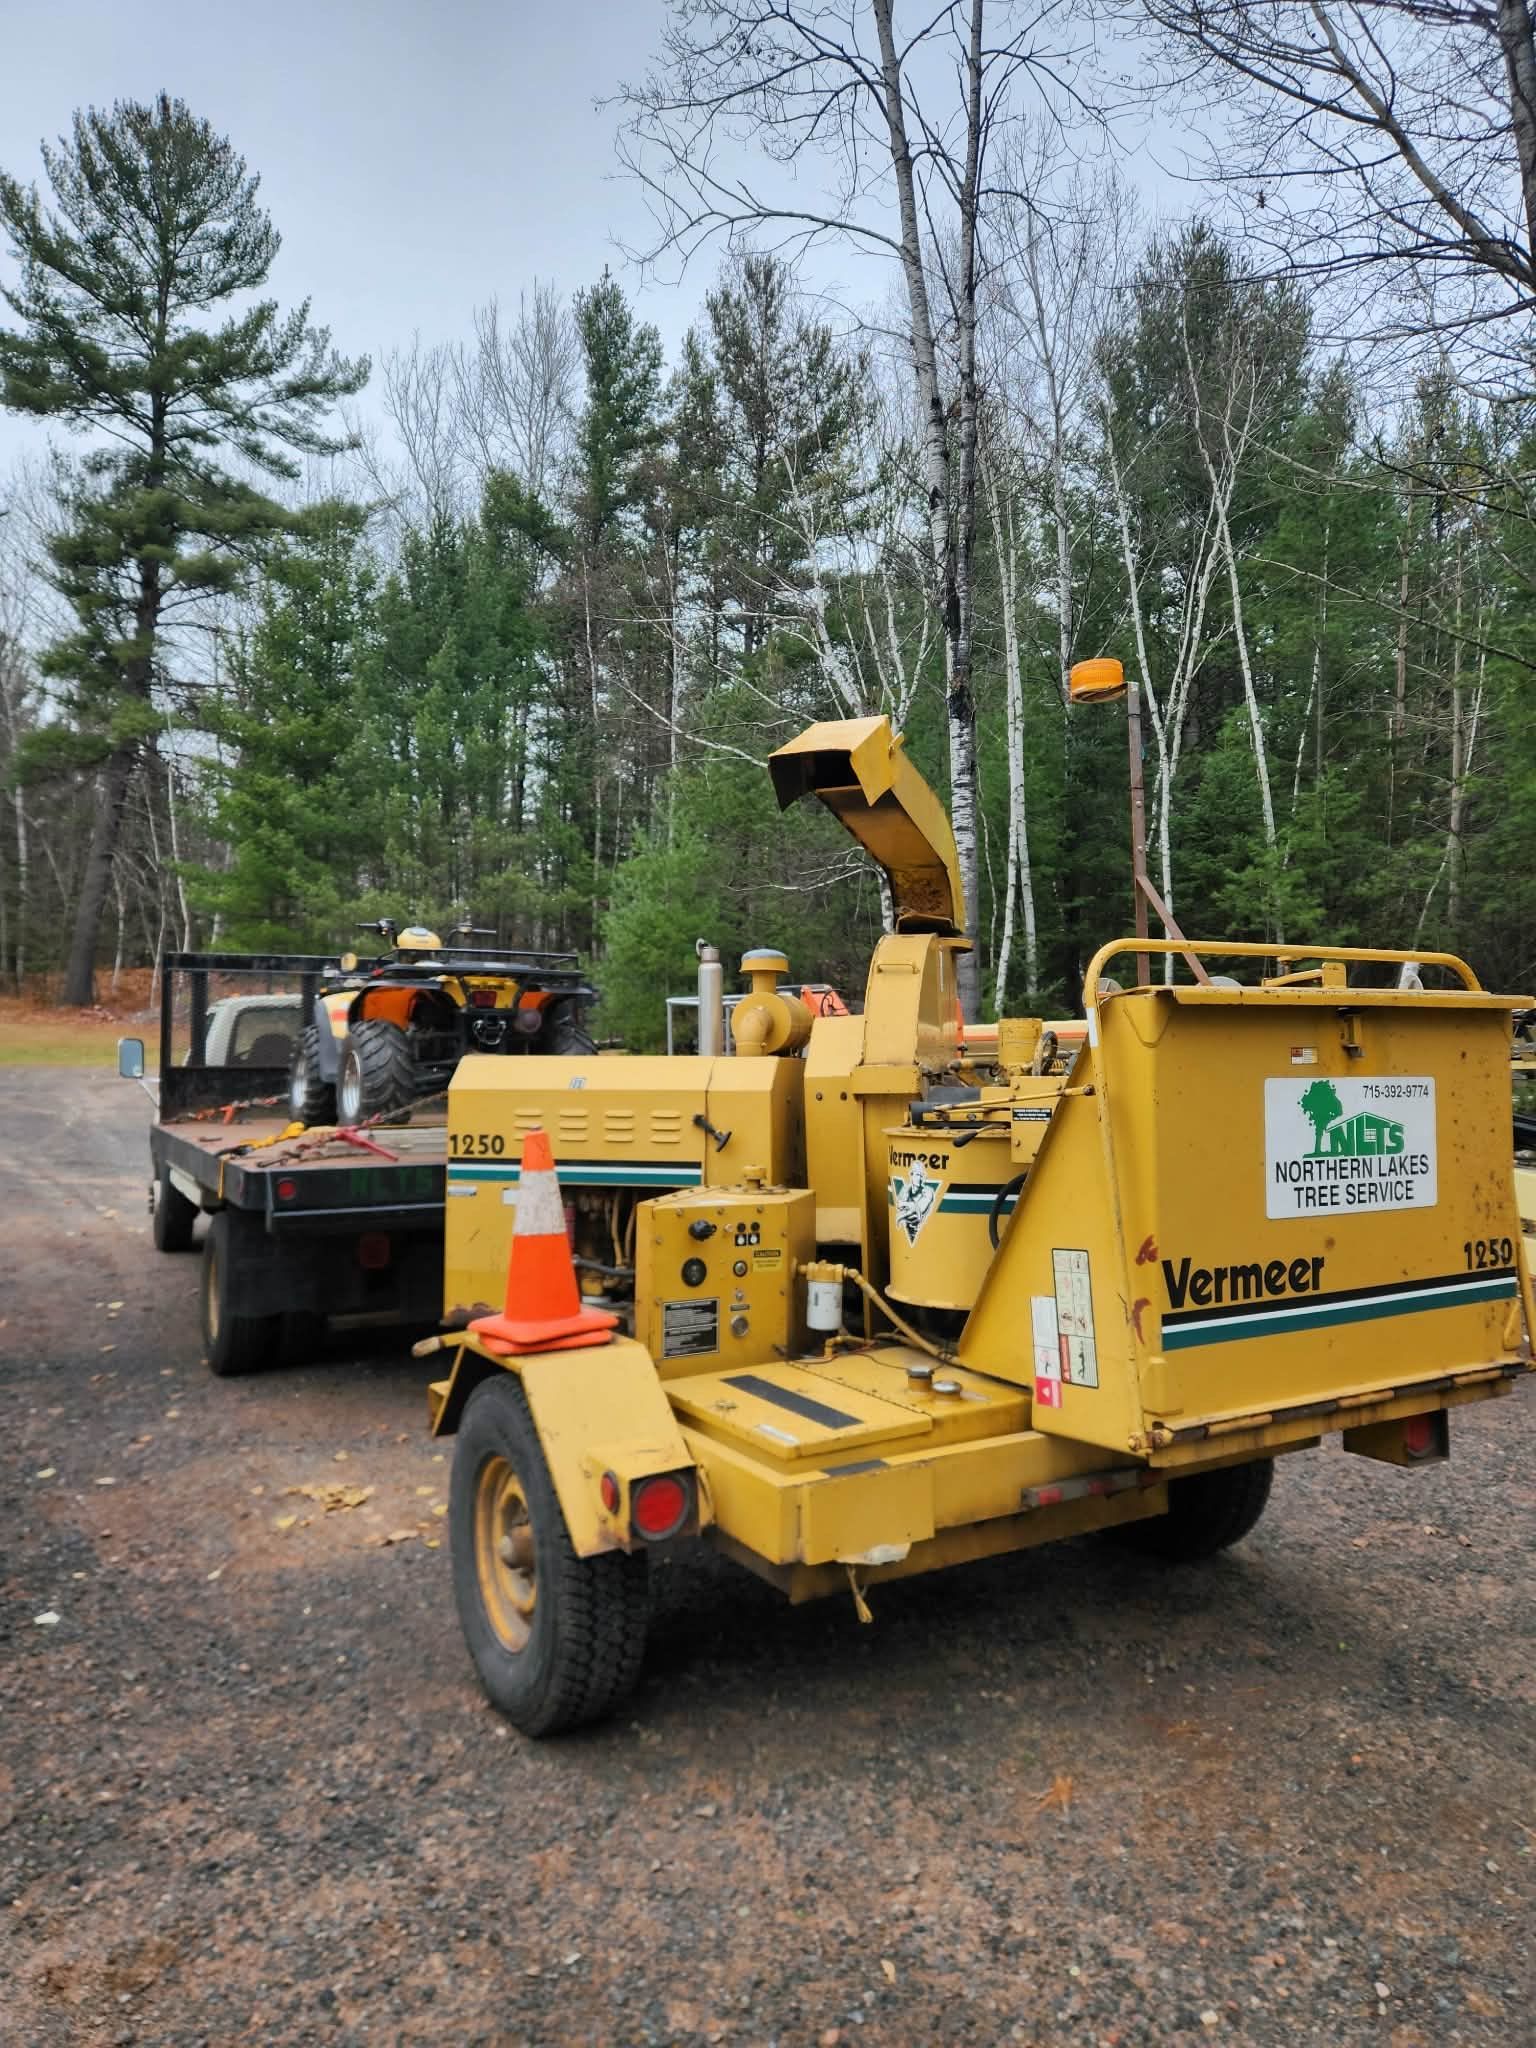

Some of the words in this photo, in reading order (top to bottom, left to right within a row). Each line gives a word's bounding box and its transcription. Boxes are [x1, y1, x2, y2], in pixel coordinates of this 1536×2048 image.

[1362, 1084, 1429, 1099] 715-392-9774
[449, 1134, 505, 1155] 1250
[1329, 1113, 1405, 1157] NLTS
[1275, 1157, 1373, 1184] NORTHERN
[1378, 1153, 1430, 1178] LAKES
[1293, 1184, 1341, 1209] TREE
[1345, 1179, 1415, 1205] SERVICE
[1463, 1237, 1513, 1270] 1250
[1161, 1256, 1325, 1309] Vermeer
